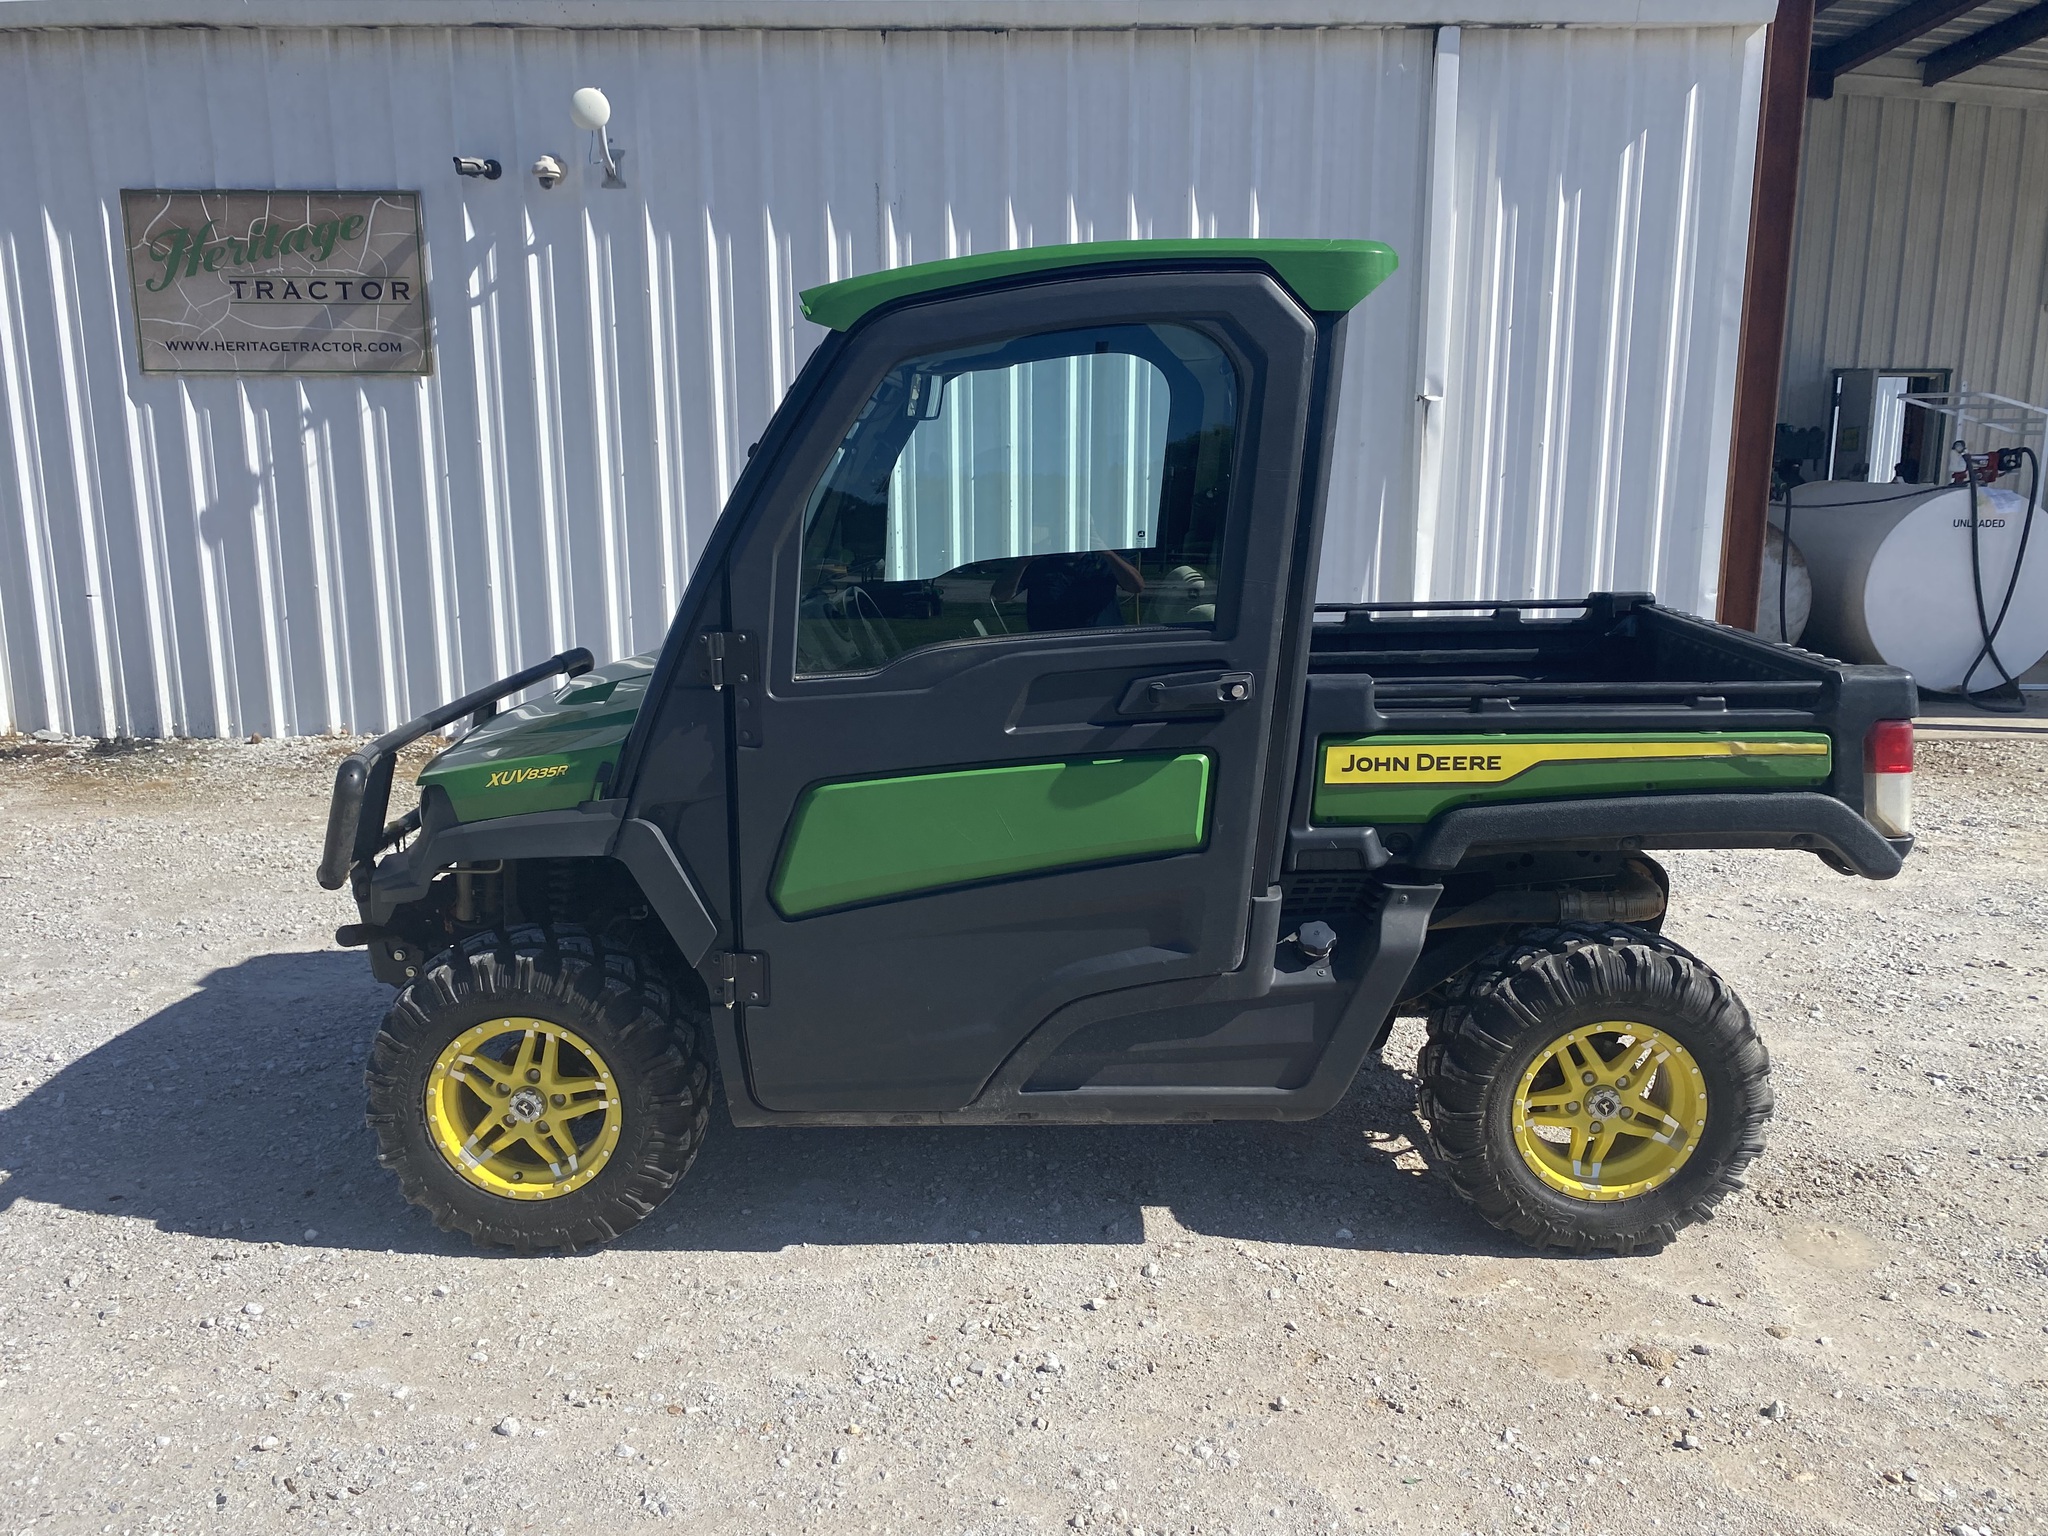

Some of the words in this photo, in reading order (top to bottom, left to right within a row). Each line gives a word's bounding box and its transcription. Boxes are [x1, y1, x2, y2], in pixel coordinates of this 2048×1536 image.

[145, 214, 365, 292] Heritage
[229, 279, 410, 301] TRACTOR
[165, 341, 402, 353] WWW.HERITAGETRACTOR.COM
[1953, 519, 2006, 528] UNLADED
[1341, 754, 1410, 772] JOHN
[1416, 753, 1502, 771] DEERE
[485, 763, 571, 788] XUV835R
